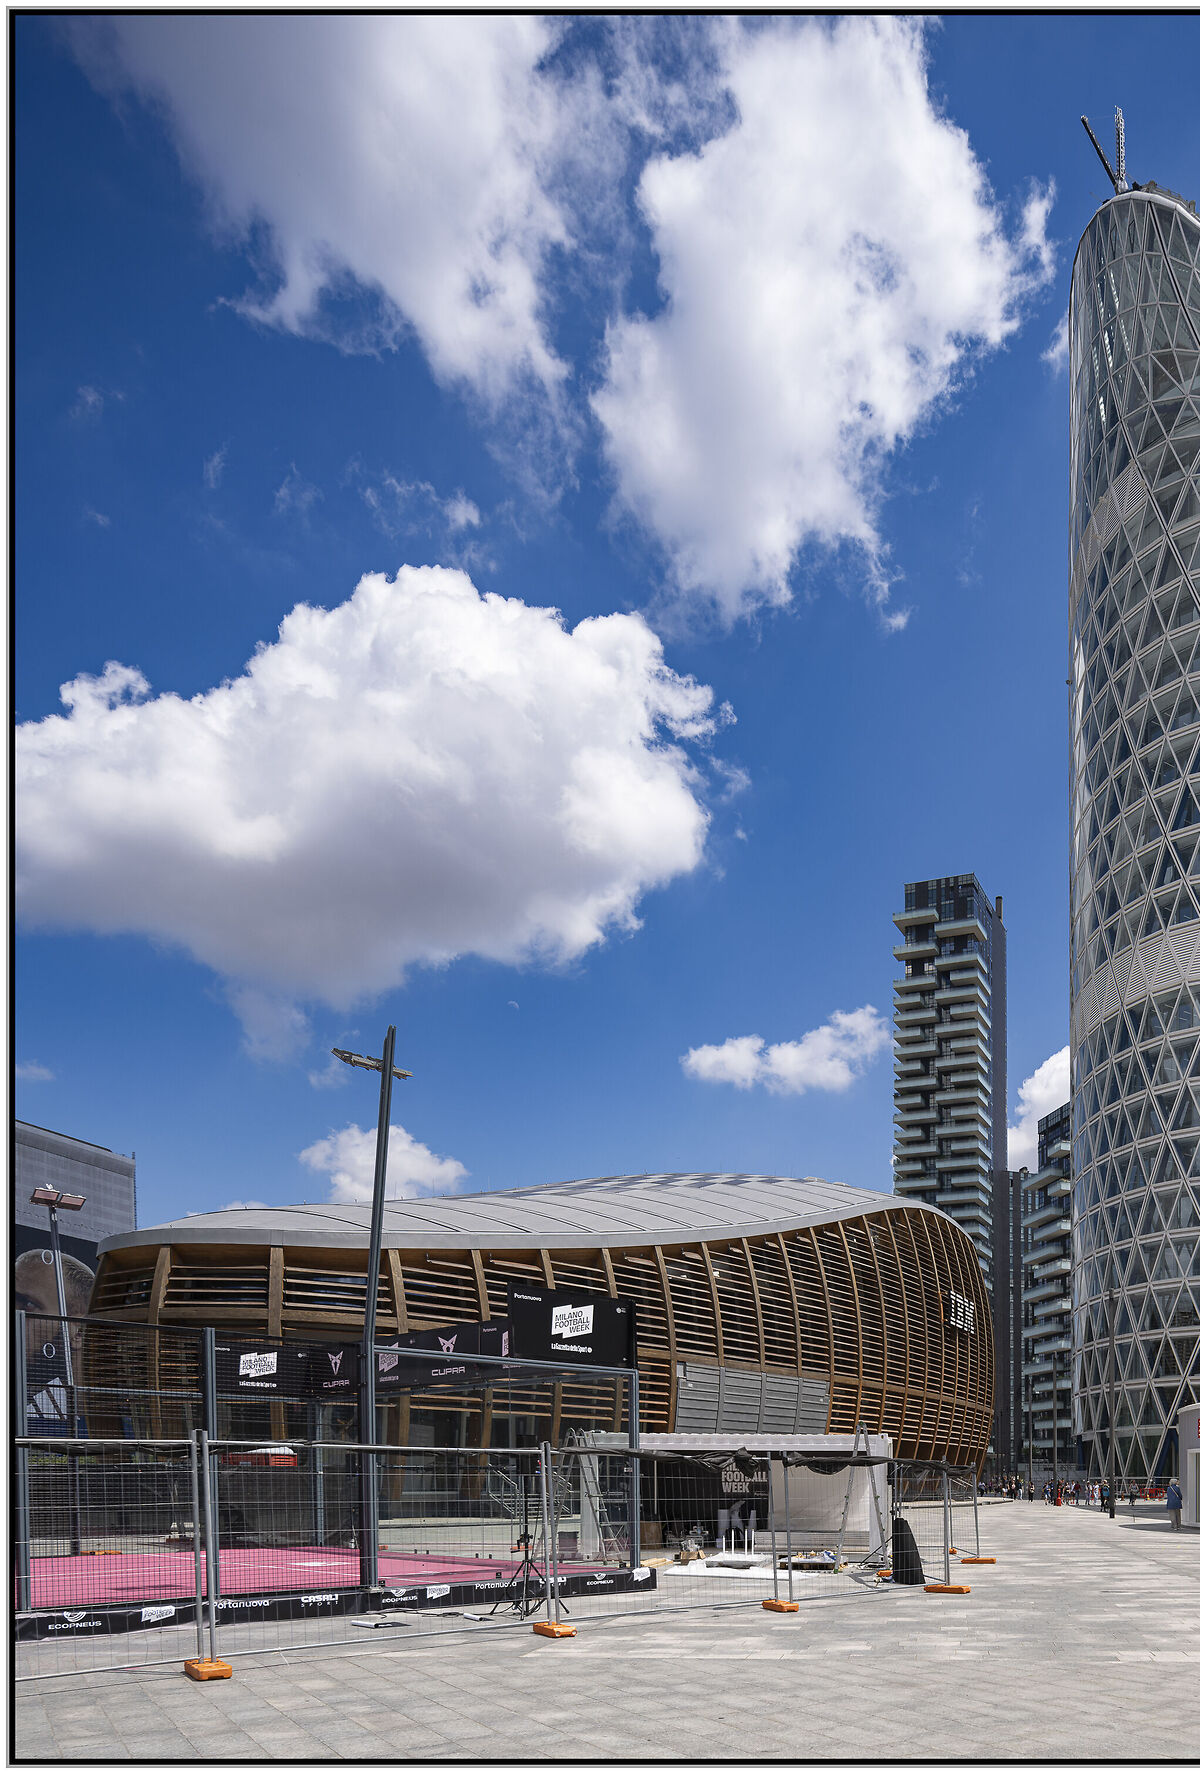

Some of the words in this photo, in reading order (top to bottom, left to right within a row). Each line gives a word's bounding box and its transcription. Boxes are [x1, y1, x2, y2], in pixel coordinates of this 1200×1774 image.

[555, 1310, 583, 1322] MILANO
[950, 1290, 974, 1334] IBM
[554, 1317, 590, 1329] FOOTBALL
[569, 1324, 590, 1334] WEEK
[431, 1366, 466, 1377] CUPRA
[322, 1380, 350, 1388] CUPRA
[721, 1482, 750, 1493] WEEK
[301, 1594, 339, 1602] CASALI
[381, 1595, 418, 1604] ECOPNEUS
[48, 1620, 102, 1630] ECOPNEUS
